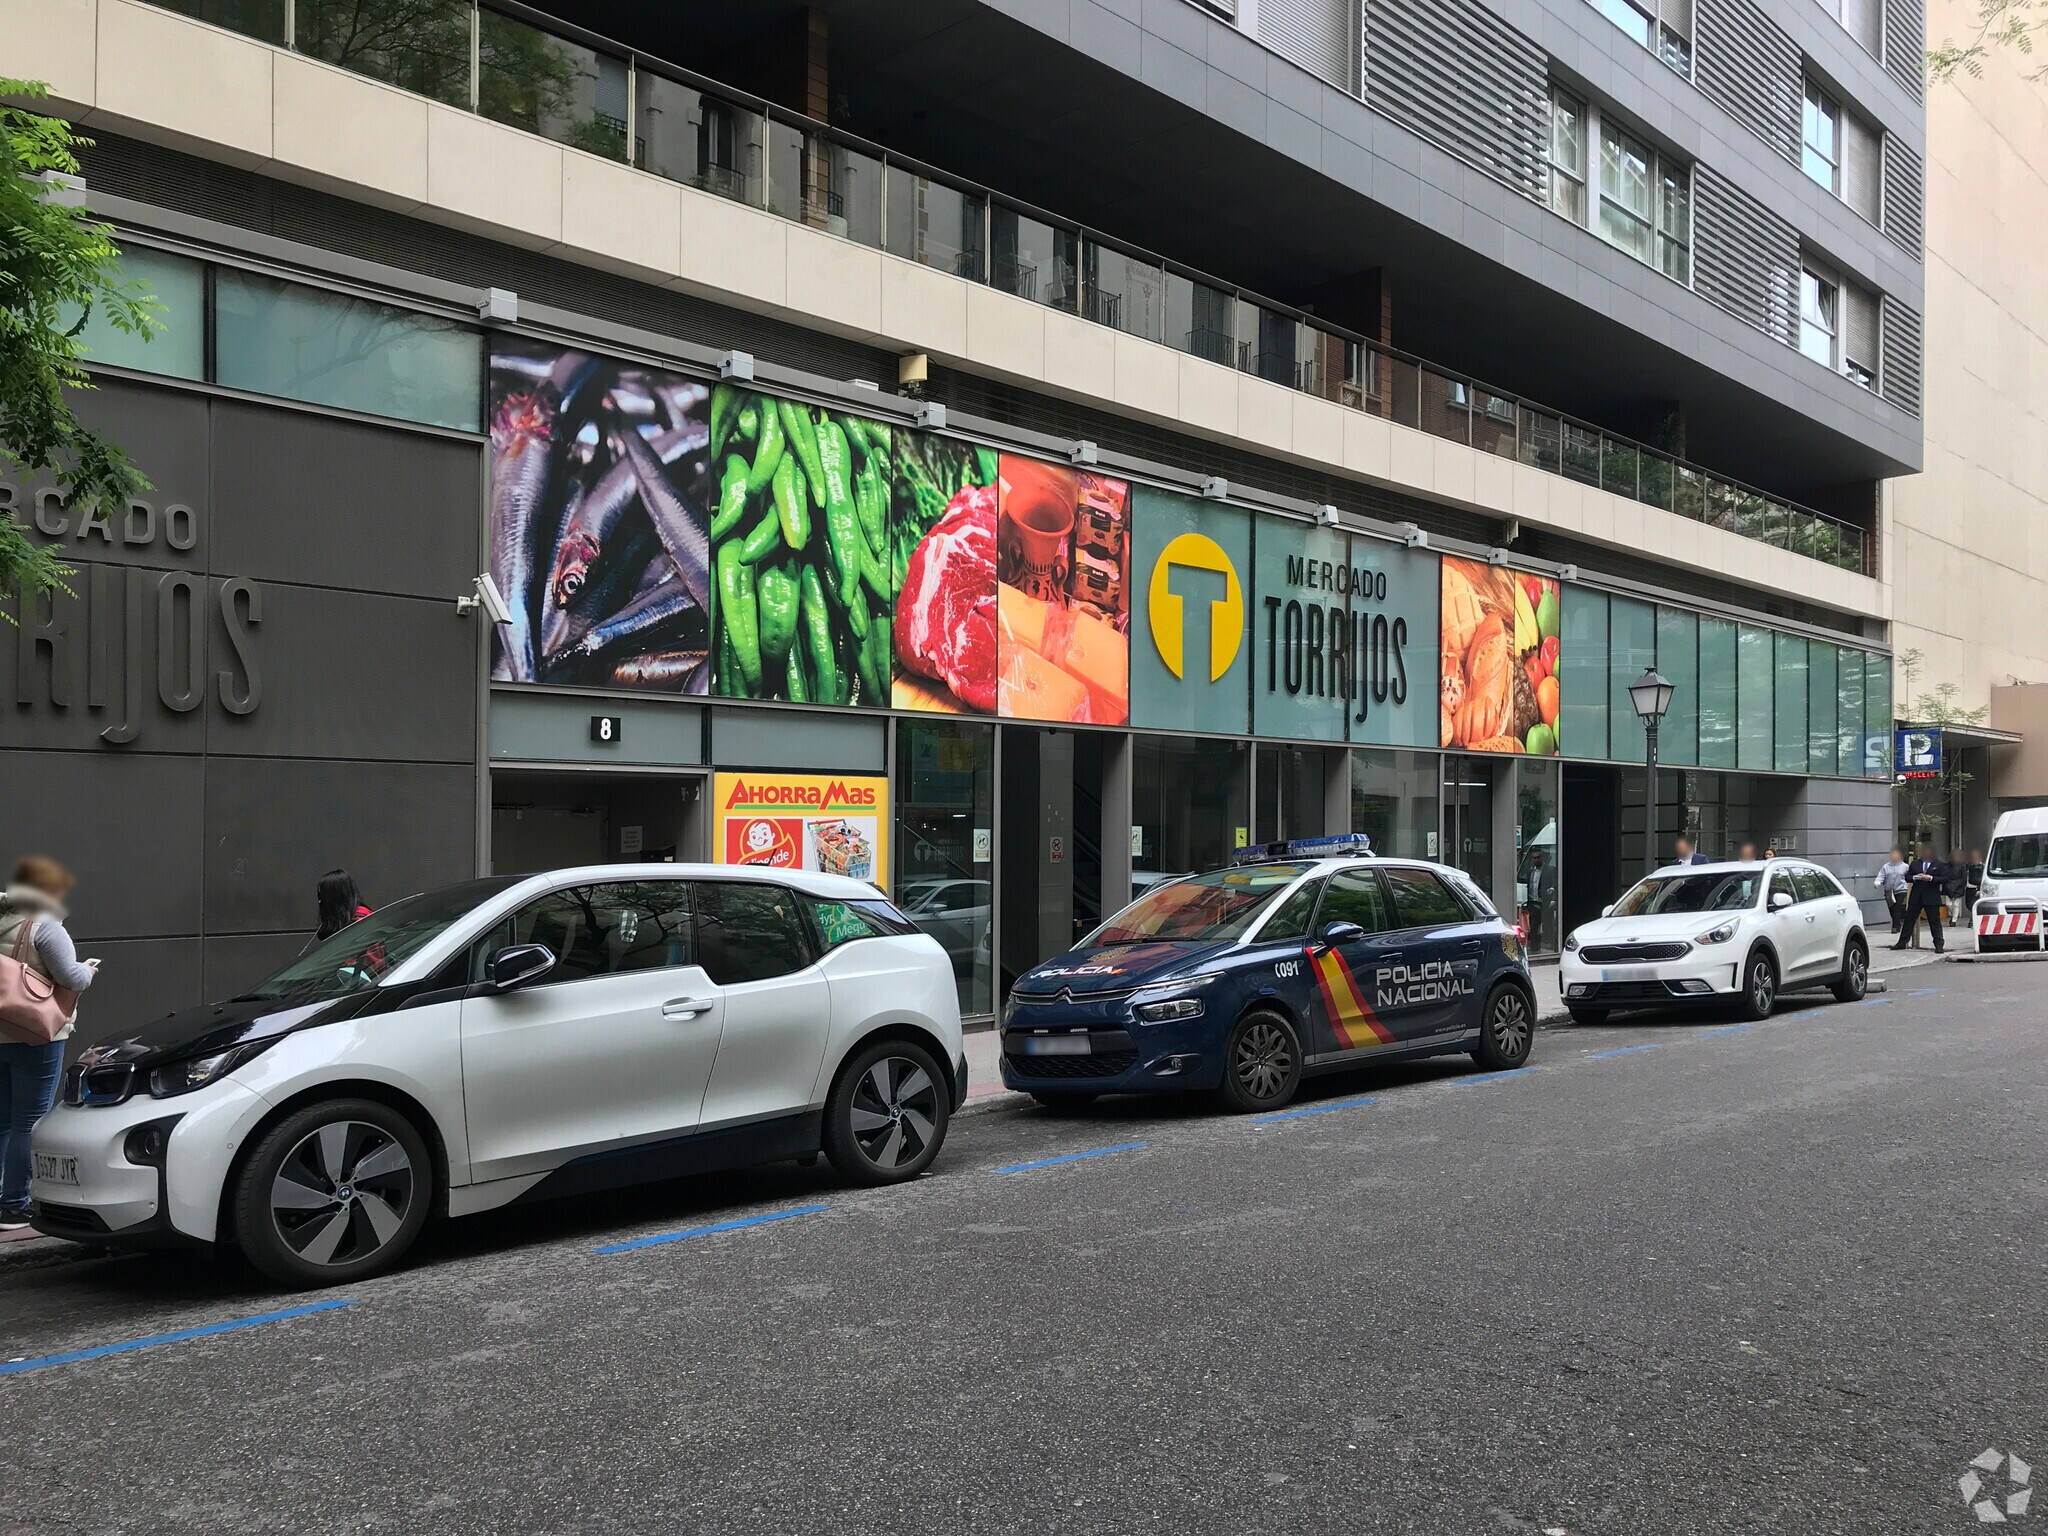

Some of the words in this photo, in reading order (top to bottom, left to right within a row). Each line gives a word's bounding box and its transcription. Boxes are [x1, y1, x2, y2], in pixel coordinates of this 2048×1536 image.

[1288, 554, 1387, 601] MERCADO
[1265, 595, 1407, 723] TORRIJOS
[600, 717, 612, 740] 8
[1904, 733, 1932, 767] P
[1281, 960, 1300, 977] 091
[1376, 957, 1454, 986] POLICÍA
[1377, 979, 1475, 1007] NACIONAL
[60, 1157, 78, 1181] JYR
